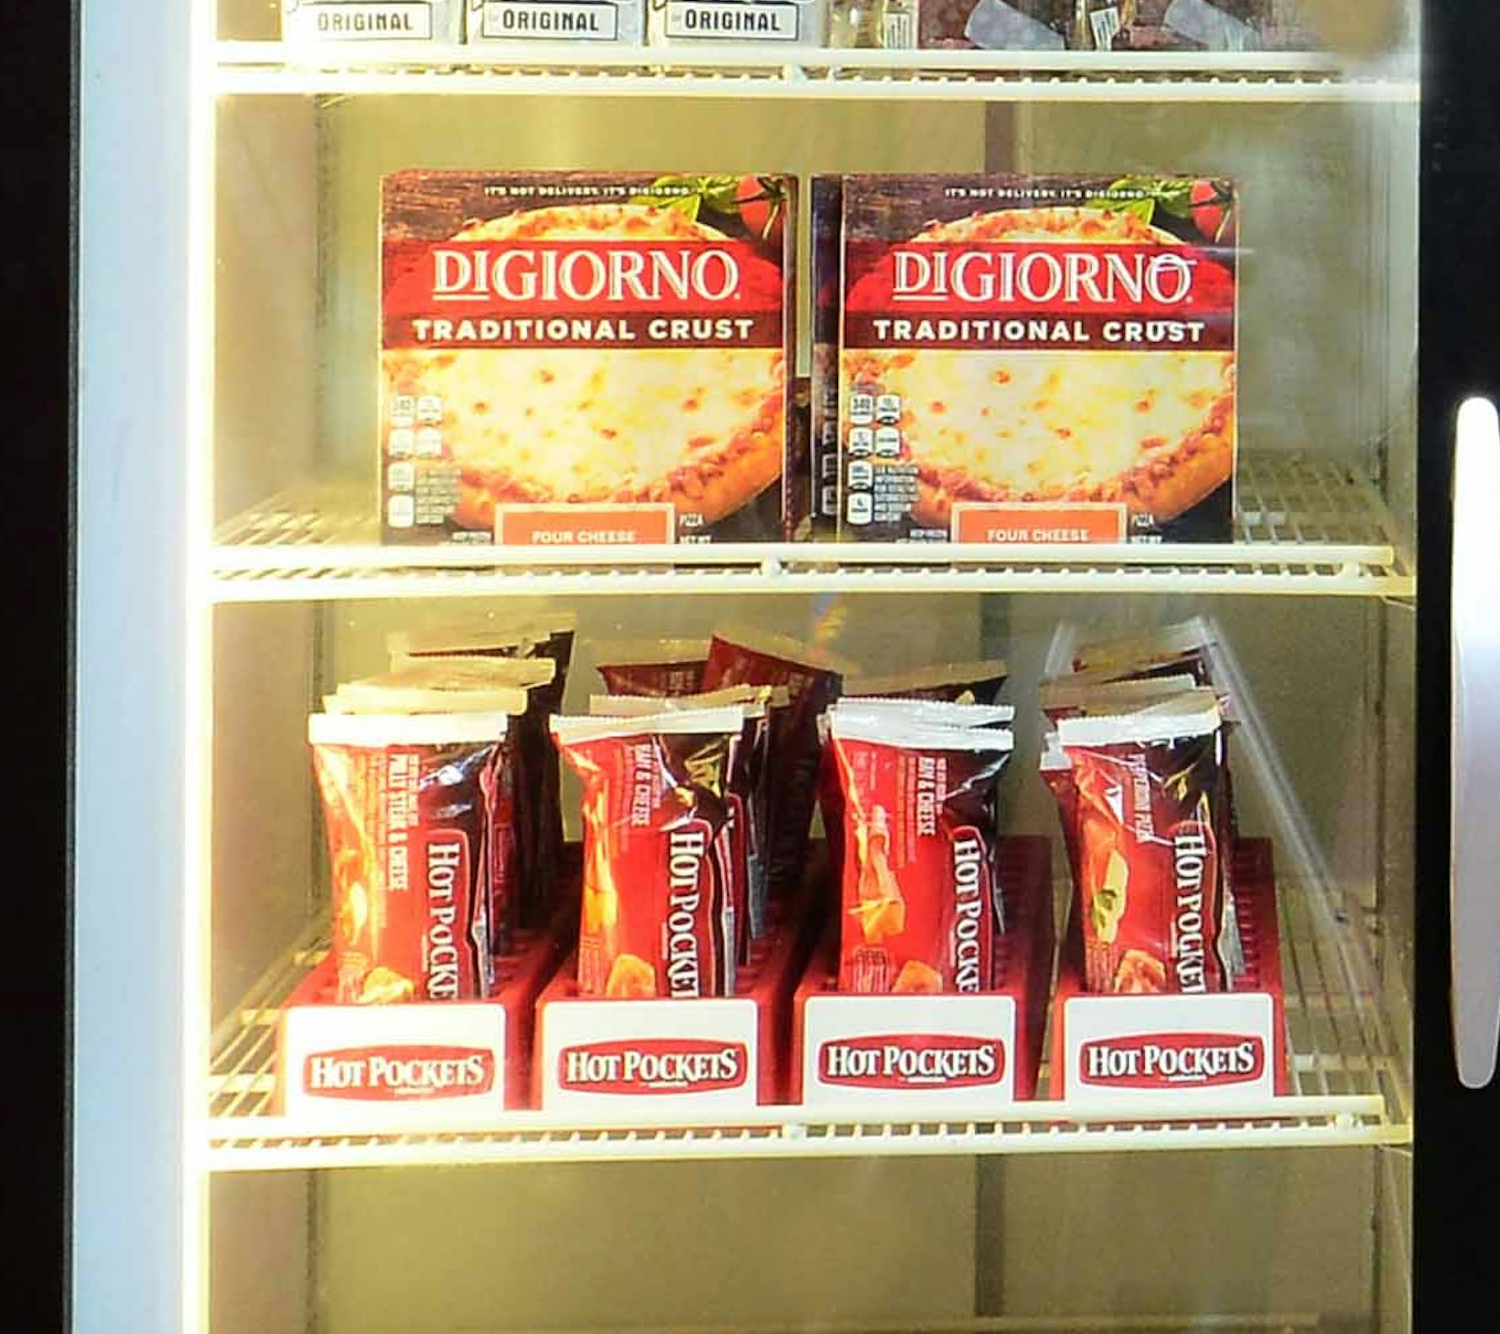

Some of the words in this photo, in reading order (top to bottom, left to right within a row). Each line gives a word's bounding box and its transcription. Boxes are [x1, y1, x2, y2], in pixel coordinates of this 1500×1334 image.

[317, 12, 414, 33] ORIGINAL
[502, 10, 600, 34] ORIGINAL
[684, 9, 782, 33] ORIGINAL
[412, 318, 636, 341] TRADITIONAL
[648, 318, 755, 341] CRUST
[873, 318, 1091, 342] TRADITIONAL
[1102, 320, 1206, 344] CRUST
[531, 529, 574, 544] FOUR
[577, 529, 636, 544] CHEESE
[987, 528, 1028, 543] FOUR
[1031, 528, 1090, 543] CHEESE
[428, 841, 462, 901] HOT
[668, 831, 705, 890] HOT
[953, 839, 980, 897] HOT
[1173, 833, 1205, 891] HOT
[428, 905, 461, 1000] POCKE
[953, 901, 982, 994] POCKE
[310, 1057, 365, 1089] HOT
[368, 1055, 485, 1089] POCKETS
[565, 1051, 620, 1084] HOT
[622, 1048, 740, 1084] POCKETS
[826, 1045, 880, 1077] HOT
[882, 1044, 998, 1078] POCKETS
[1086, 1045, 1141, 1078] HOT
[1143, 1042, 1257, 1078] POCKETS
